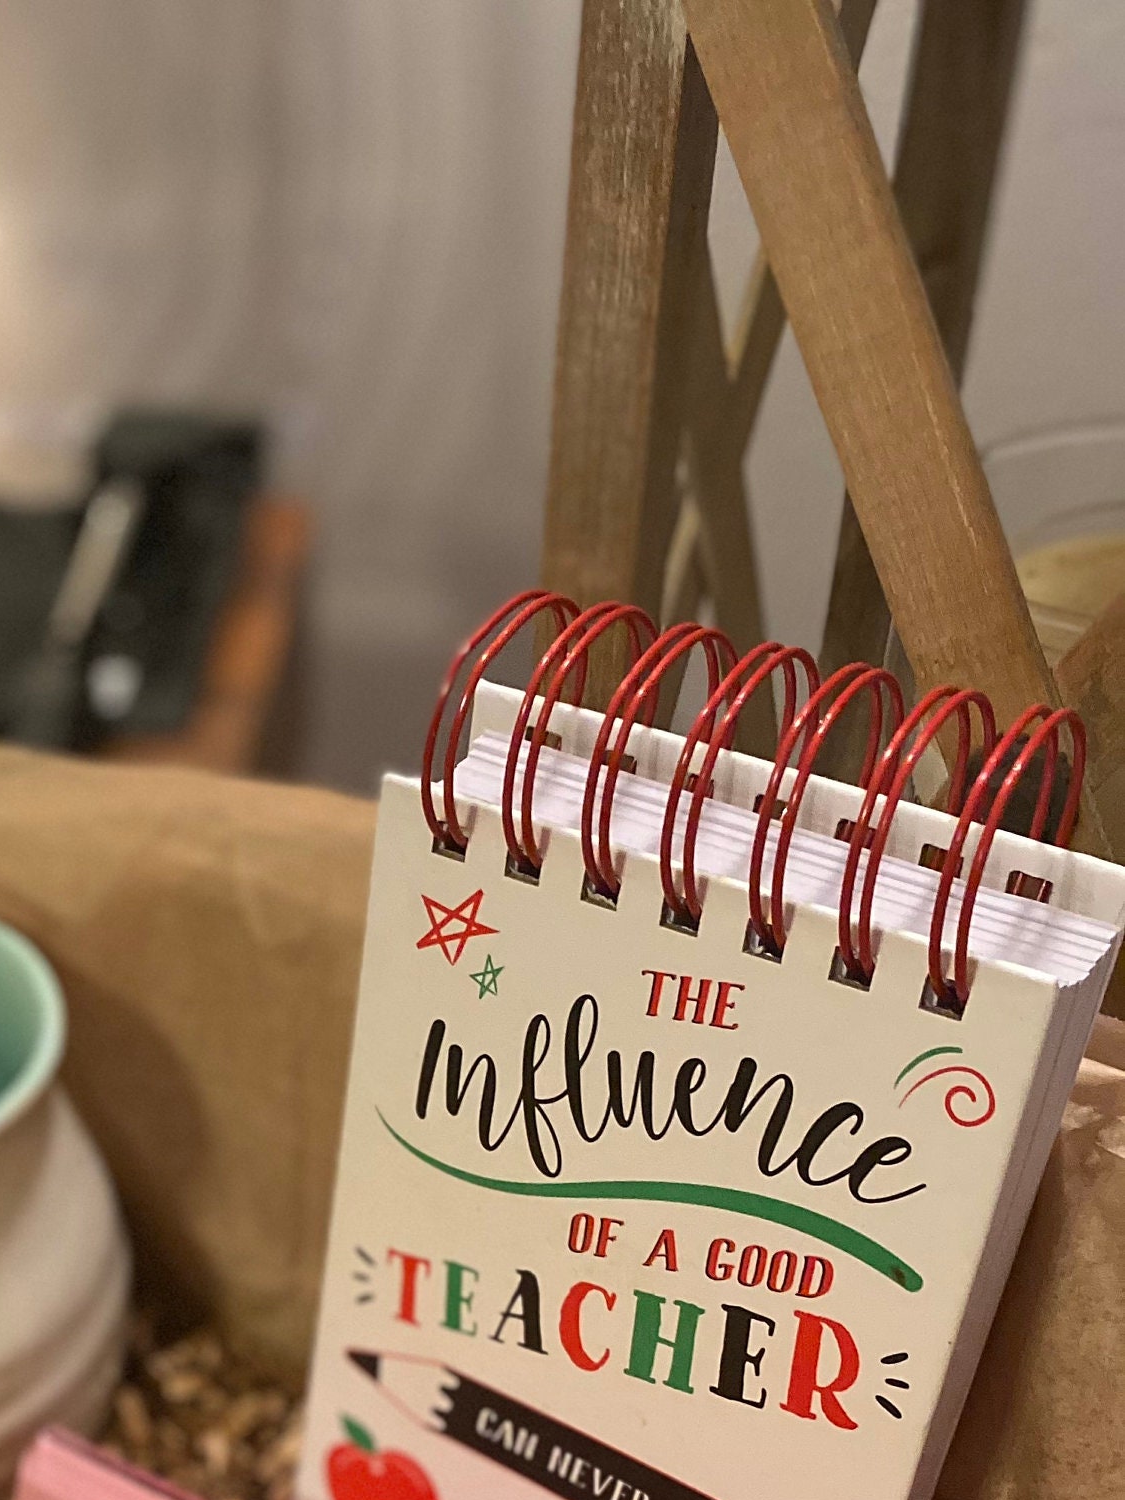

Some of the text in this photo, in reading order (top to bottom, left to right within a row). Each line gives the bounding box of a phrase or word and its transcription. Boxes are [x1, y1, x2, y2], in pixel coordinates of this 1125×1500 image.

[642, 970, 745, 1030] THE
[415, 994, 927, 1204] Influence
[567, 1213, 835, 1300] OF A GOOD
[386, 1247, 861, 1431] TEACHER
[475, 1407, 539, 1461] CAN
